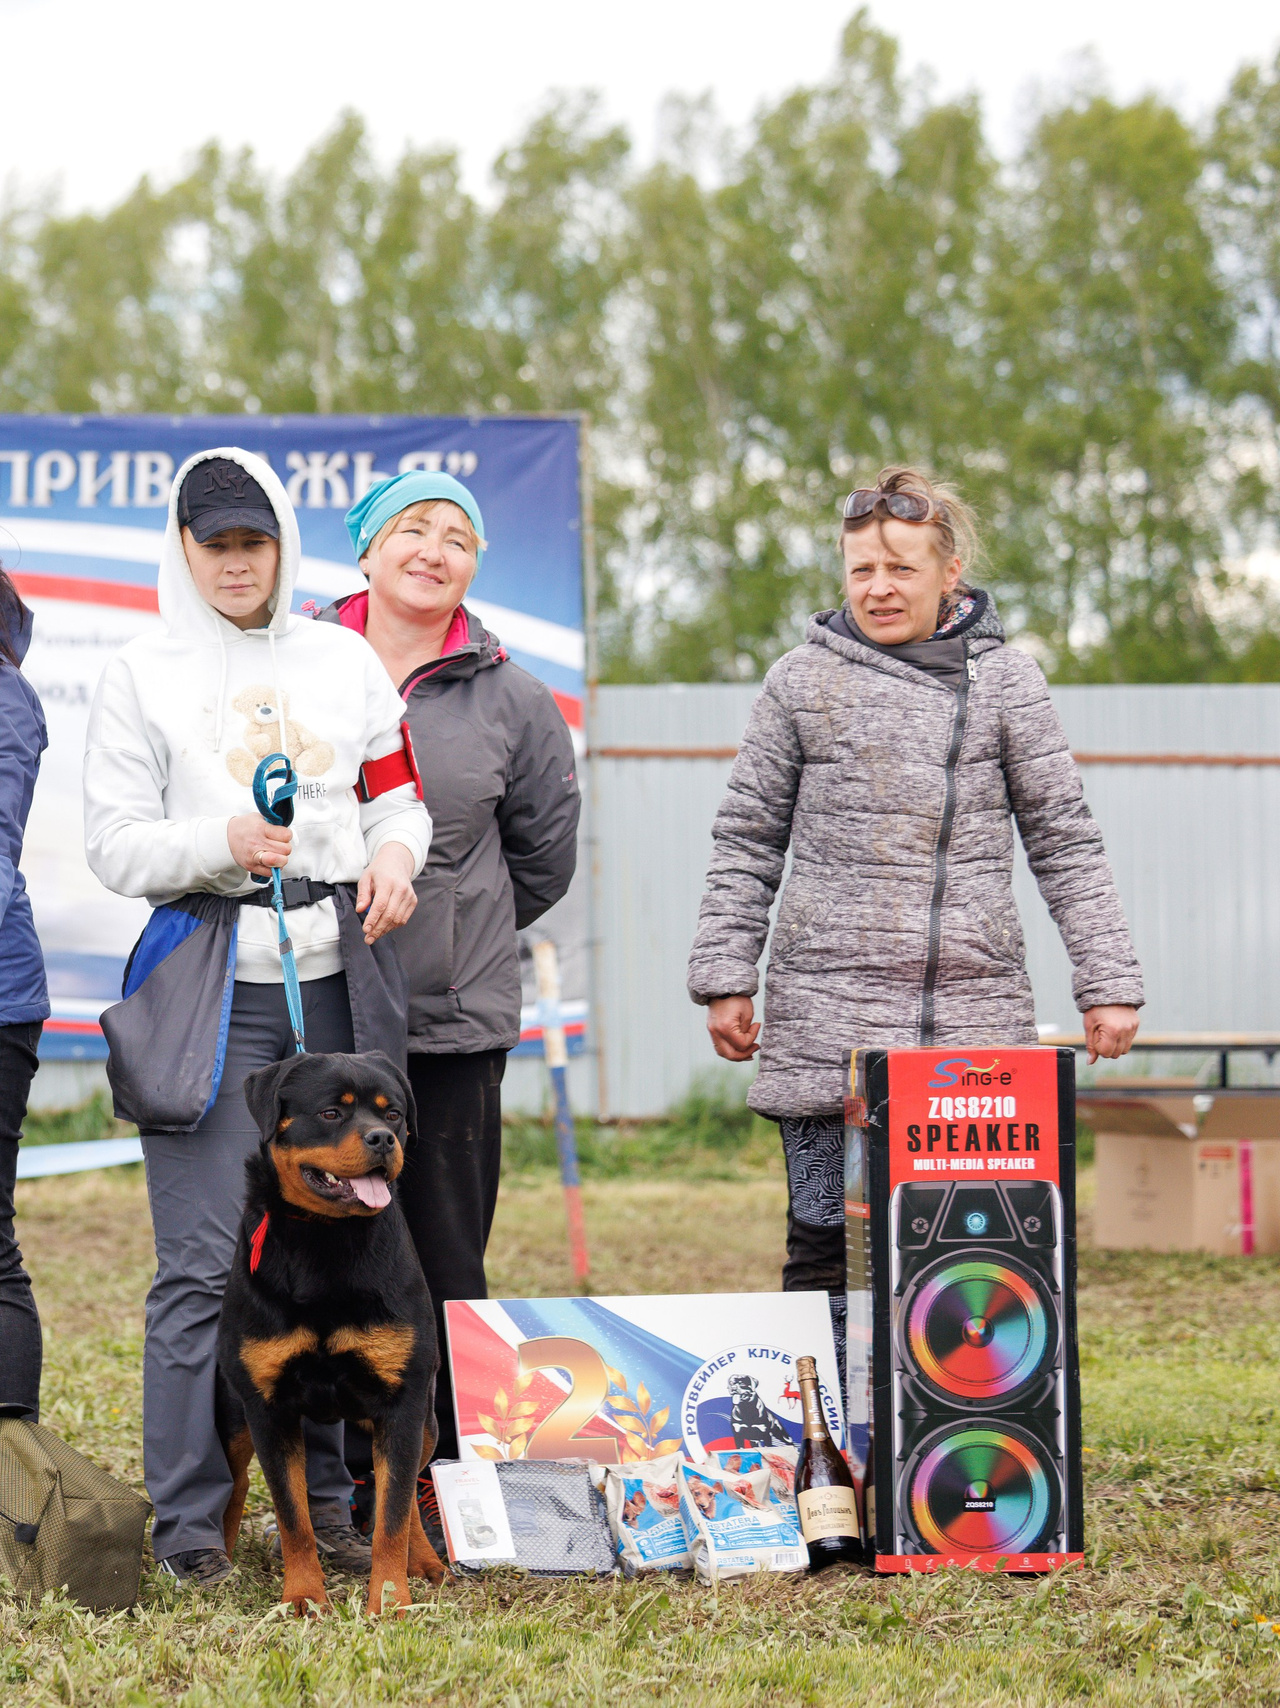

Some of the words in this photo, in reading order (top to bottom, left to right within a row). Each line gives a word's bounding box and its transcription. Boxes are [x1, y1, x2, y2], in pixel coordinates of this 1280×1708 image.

[204, 465, 252, 499] NY
[927, 1096, 1016, 1121] ZQS8210
[907, 1123, 1040, 1153] SPEAKER
[913, 1158, 984, 1171] MULTI-MEDIA
[987, 1158, 1036, 1170] SPEAKER
[517, 1335, 621, 1465] 2
[685, 1351, 737, 1436] РОТВЕЙЛЕР
[747, 1348, 793, 1365] КЛУБ
[818, 1383, 840, 1431] ССИИ
